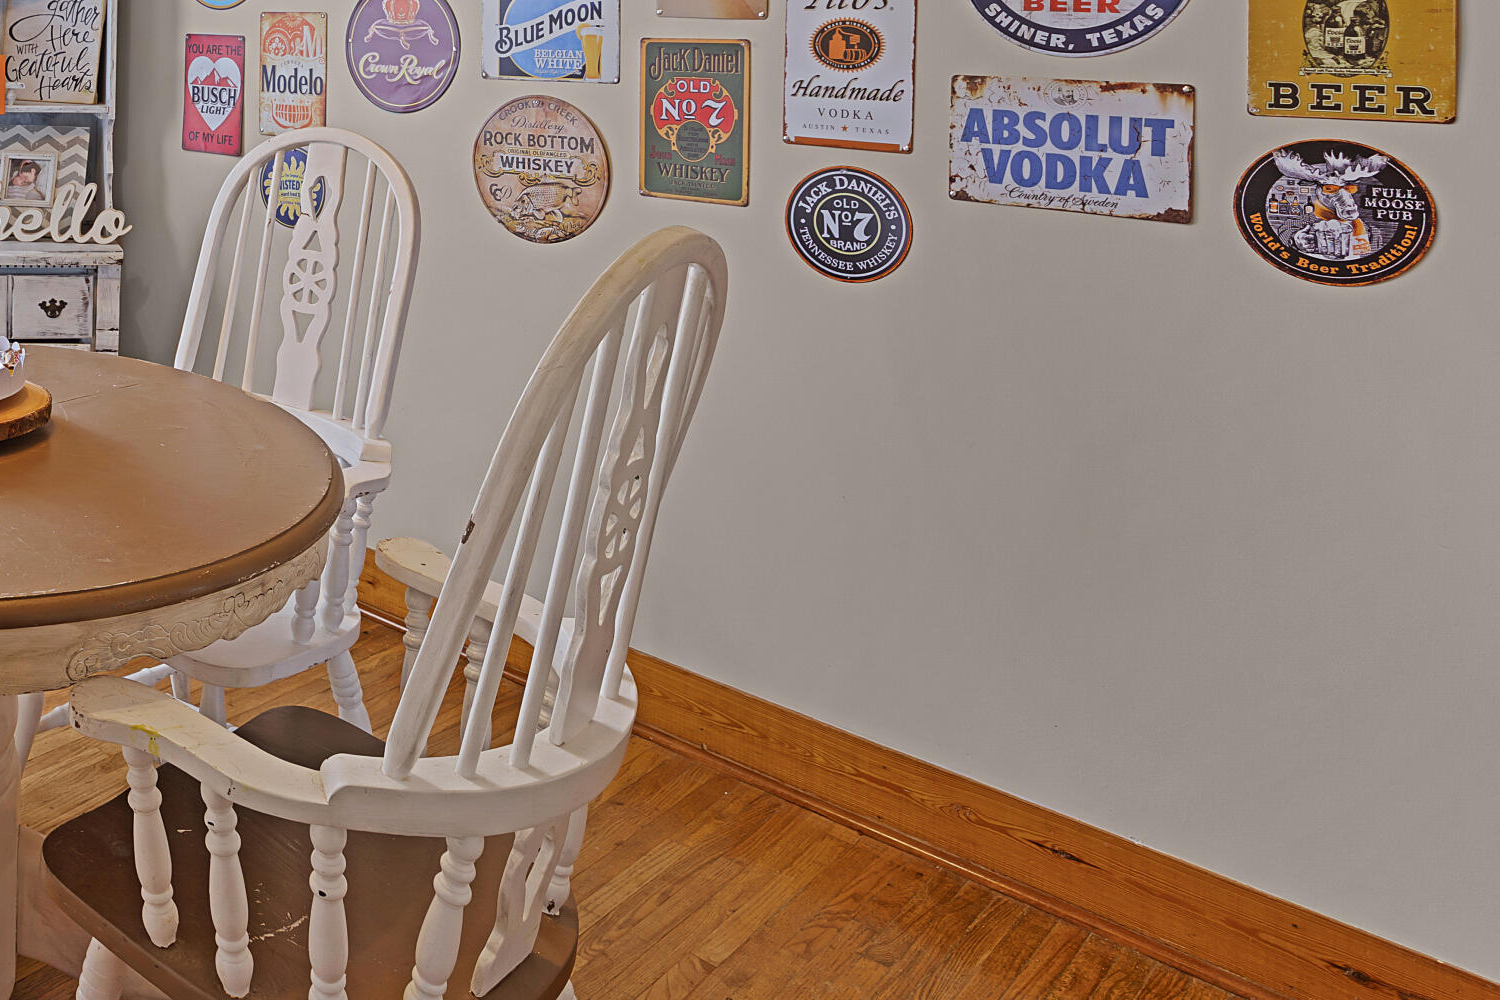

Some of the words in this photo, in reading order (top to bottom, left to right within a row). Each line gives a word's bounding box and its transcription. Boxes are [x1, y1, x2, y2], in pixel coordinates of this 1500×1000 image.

[46, 25, 95, 52] Here
[495, 20, 545, 54] BLUE
[548, 0, 602, 34] MOON
[984, 3, 1074, 50] SHINER,
[1086, 3, 1164, 47] TEXAS
[16, 43, 38, 55] WITH
[188, 43, 204, 55] YOU
[206, 44, 224, 56] ARE
[226, 45, 242, 57] THE
[534, 49, 583, 59] BELGIAN
[359, 52, 399, 79] Crown
[385, 54, 446, 84] Royal
[535, 58, 583, 70] WHITE
[650, 47, 691, 81] Jack
[691, 47, 741, 75] Daniel
[34, 69, 94, 100] Hearts
[261, 64, 324, 96] Modelo
[676, 80, 711, 93] OLD
[790, 75, 905, 102] Handmade
[191, 85, 238, 108] BUSCH
[1266, 81, 1437, 116] BEER
[199, 105, 227, 116] LIGHT
[499, 100, 544, 121] CROOKED
[548, 103, 579, 126] CREEK
[701, 99, 727, 127] 7
[816, 107, 874, 121] VODKA
[511, 115, 565, 134] Distillery
[802, 123, 835, 131] AUSTIN
[855, 126, 890, 135] TEXAS
[960, 107, 1175, 157] ABSOLUT
[188, 131, 200, 142] OF
[202, 132, 216, 144] MY
[217, 133, 234, 146] LIFE
[483, 130, 523, 147] ROCK
[527, 134, 595, 154] BOTTOM
[500, 155, 574, 174] WHISKEY
[657, 162, 731, 183] WHISKEY
[980, 147, 1149, 199] VODKA
[798, 181, 832, 213] JACK
[833, 175, 899, 220] DANIEL'S
[833, 198, 859, 209] OLD
[1004, 184, 1057, 207] Country
[1058, 194, 1074, 208] of
[1072, 195, 1119, 209] Sweden
[1364, 199, 1426, 211] MOOSE
[1371, 187, 1418, 199] FULL
[853, 211, 875, 241] 7
[1376, 210, 1413, 221] PUB
[800, 227, 854, 271] TENNESSEE
[856, 233, 898, 271] WHISKEY
[829, 240, 867, 251] BRAND
[1249, 212, 1291, 260] World's
[1296, 256, 1340, 275] Beer
[1346, 224, 1419, 275] Tradition!
